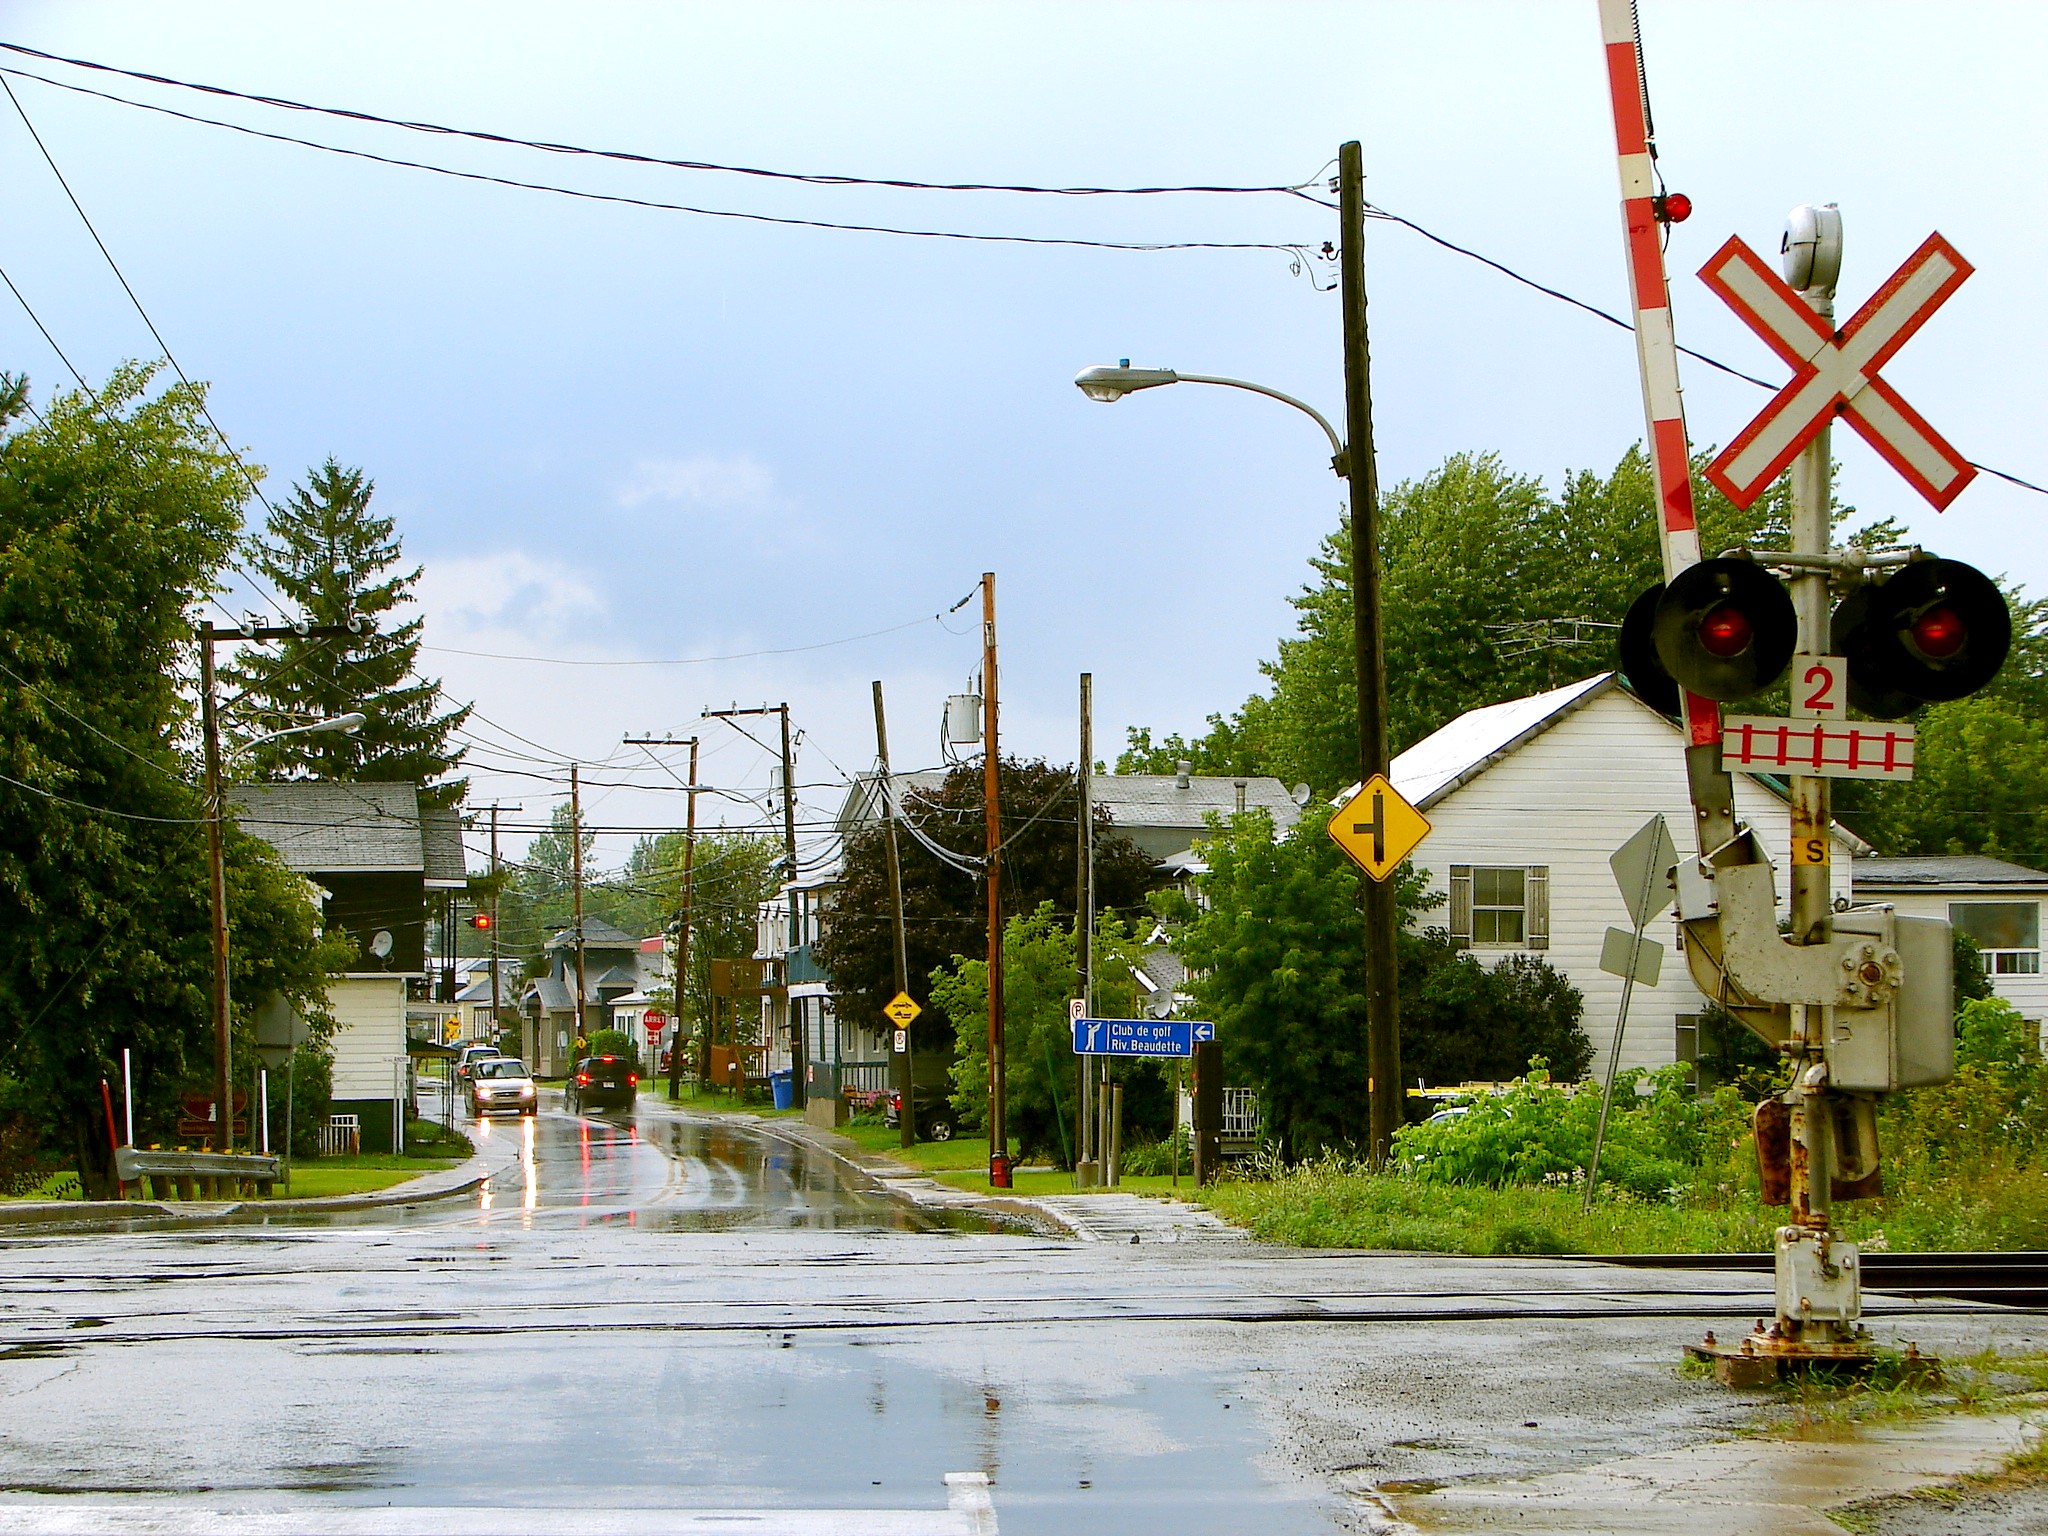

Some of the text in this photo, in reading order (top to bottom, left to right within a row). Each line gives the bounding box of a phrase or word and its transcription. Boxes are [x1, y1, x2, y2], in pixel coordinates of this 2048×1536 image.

[1804, 666, 1834, 710] 2
[1806, 839, 1824, 863] S
[1111, 1024, 1172, 1040] Club de golf
[1111, 1039, 1182, 1053] Riv. Beaudette
